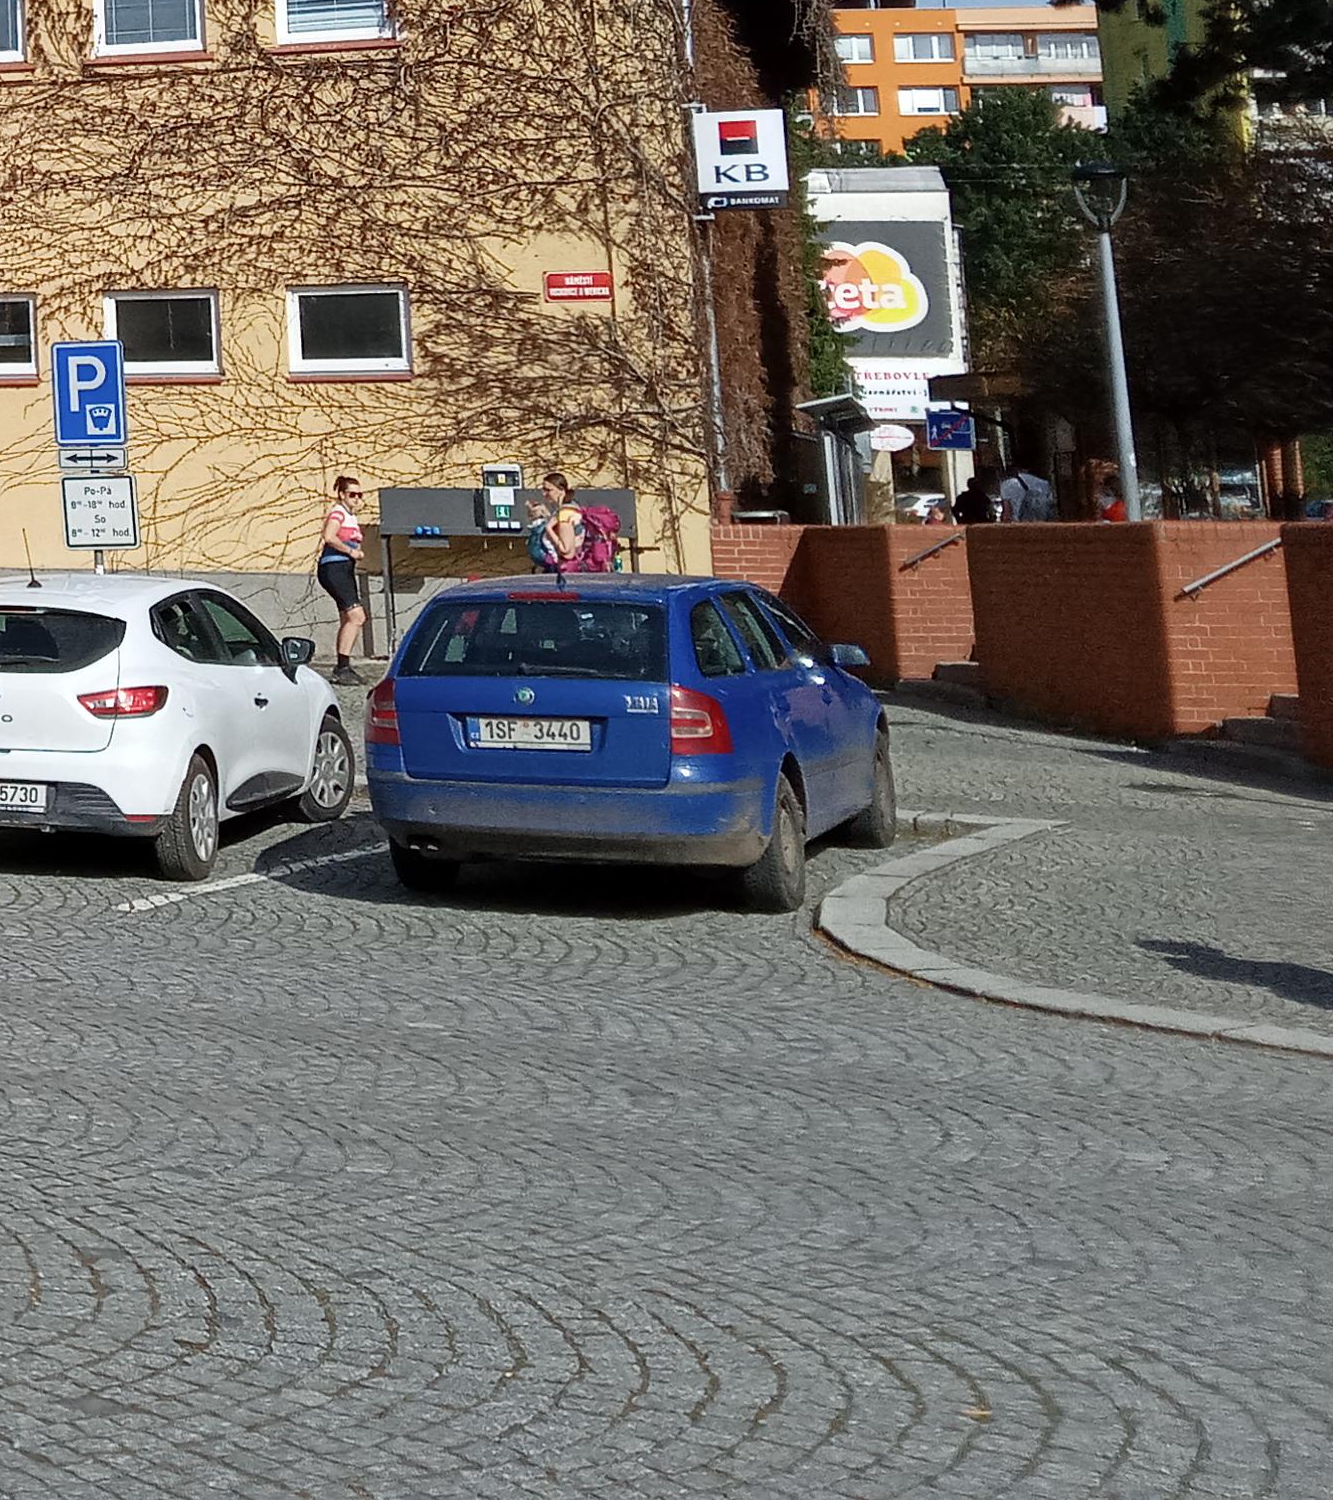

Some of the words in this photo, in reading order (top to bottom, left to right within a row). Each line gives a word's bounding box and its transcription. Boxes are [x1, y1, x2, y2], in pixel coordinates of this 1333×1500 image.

[714, 163, 770, 184] KB
[67, 355, 107, 413] P
[94, 514, 106, 523] So
[485, 721, 518, 740] 1SF
[533, 722, 581, 741] 3440
[0, 785, 38, 803] 5730
